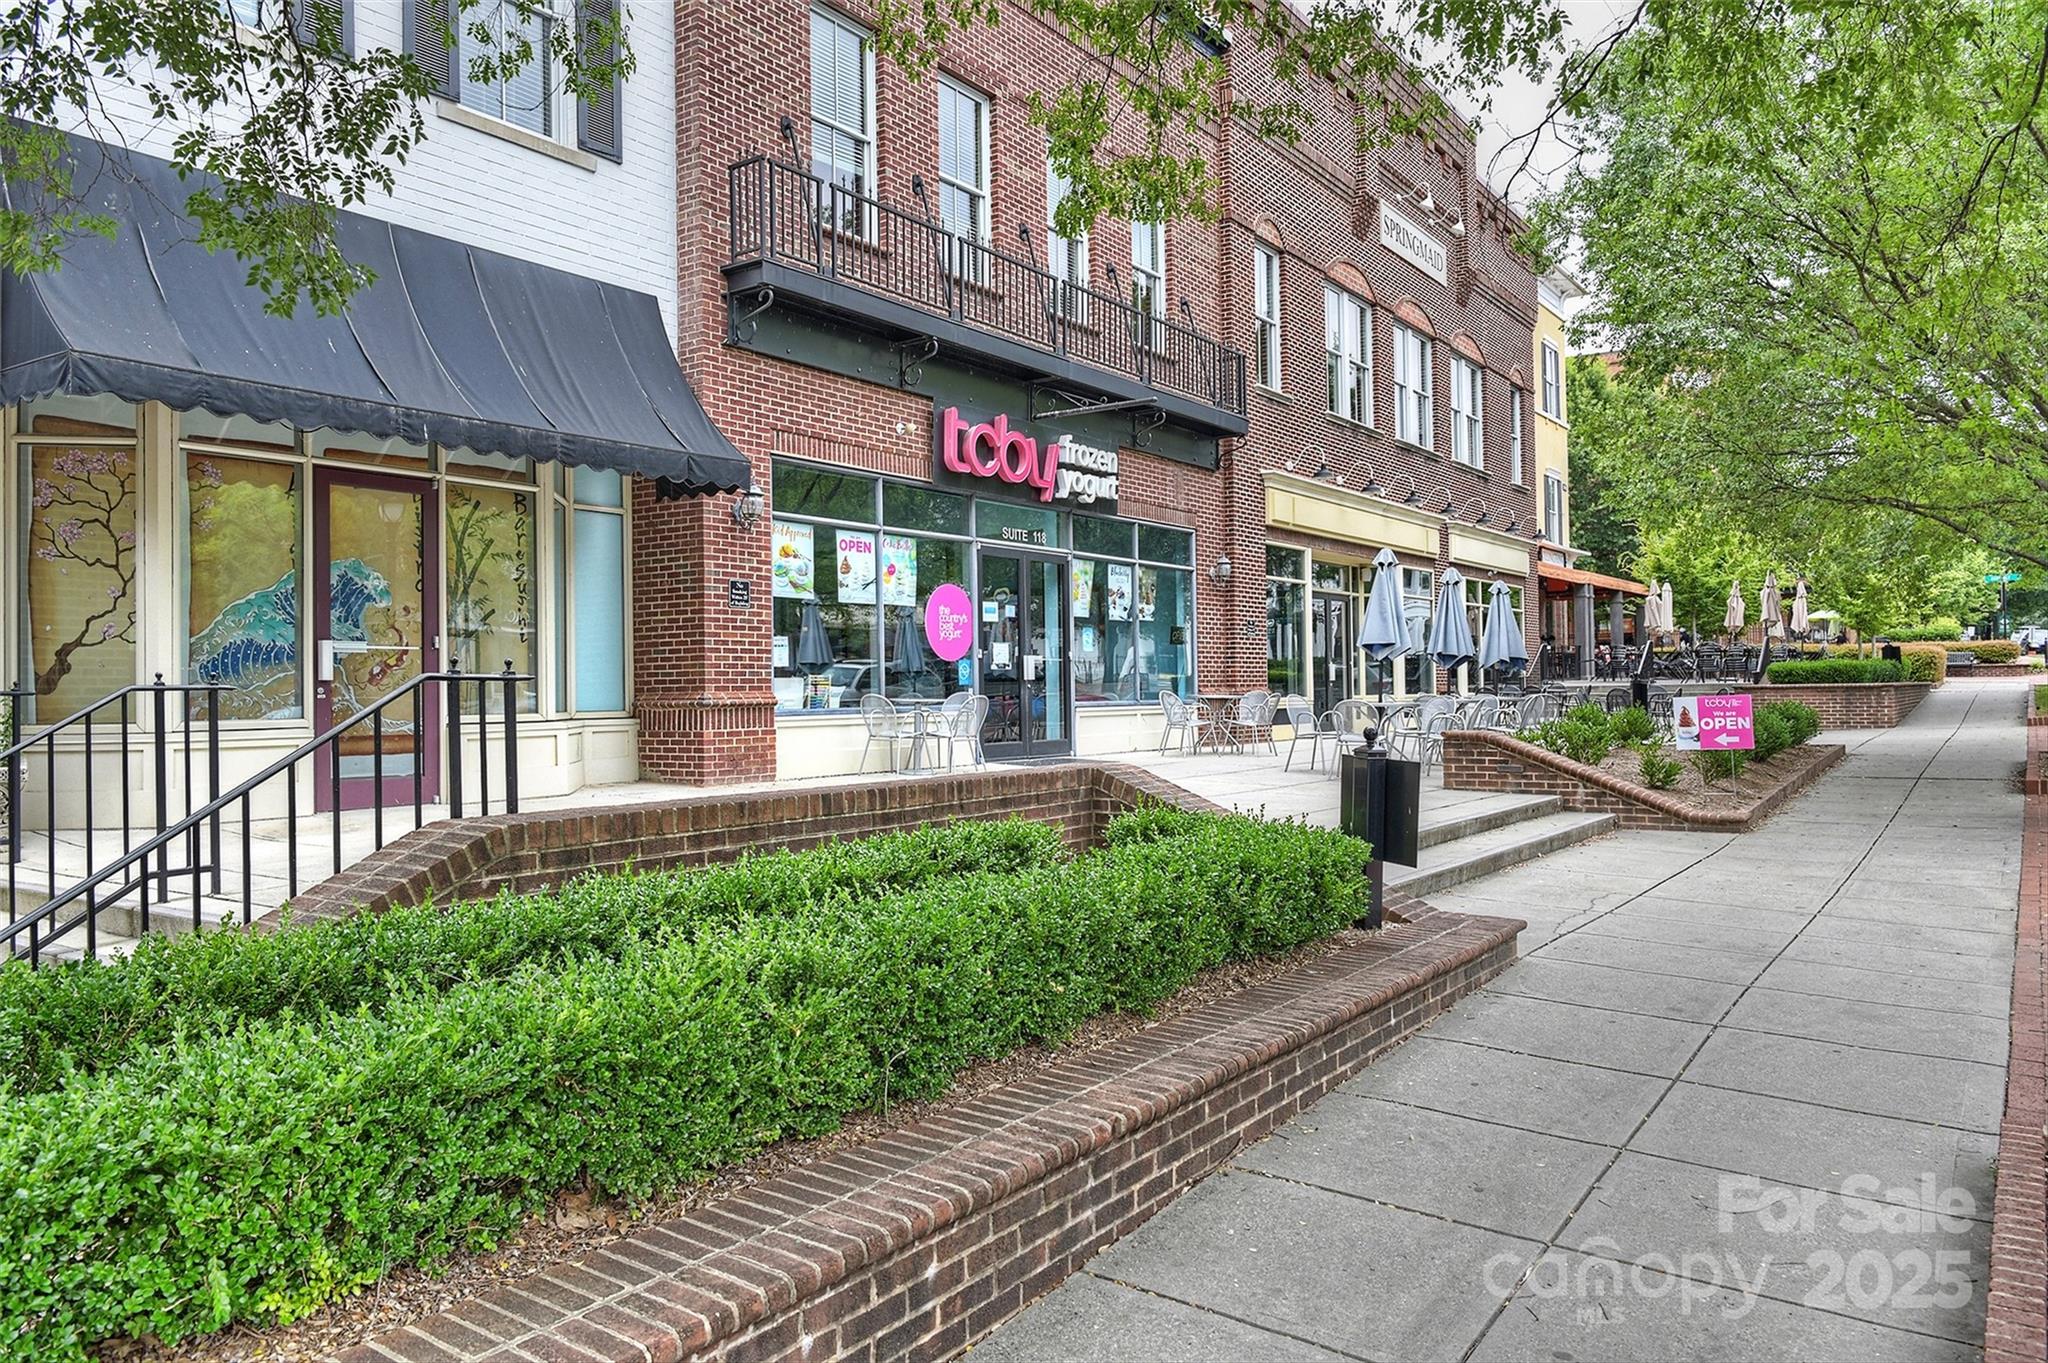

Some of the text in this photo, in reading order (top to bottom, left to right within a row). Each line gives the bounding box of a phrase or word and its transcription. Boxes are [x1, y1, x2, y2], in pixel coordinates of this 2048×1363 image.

[1384, 214, 1444, 272] SPRINGMAID
[943, 406, 1060, 503] tcby
[1058, 434, 1118, 474] frozen
[1055, 468, 1119, 504] yogurt
[1002, 526, 1047, 544] SUITE 118
[839, 538, 872, 554] OPEN
[939, 604, 950, 615] the
[1705, 698, 1731, 708] tcby
[1700, 716, 1750, 730] OPEN
